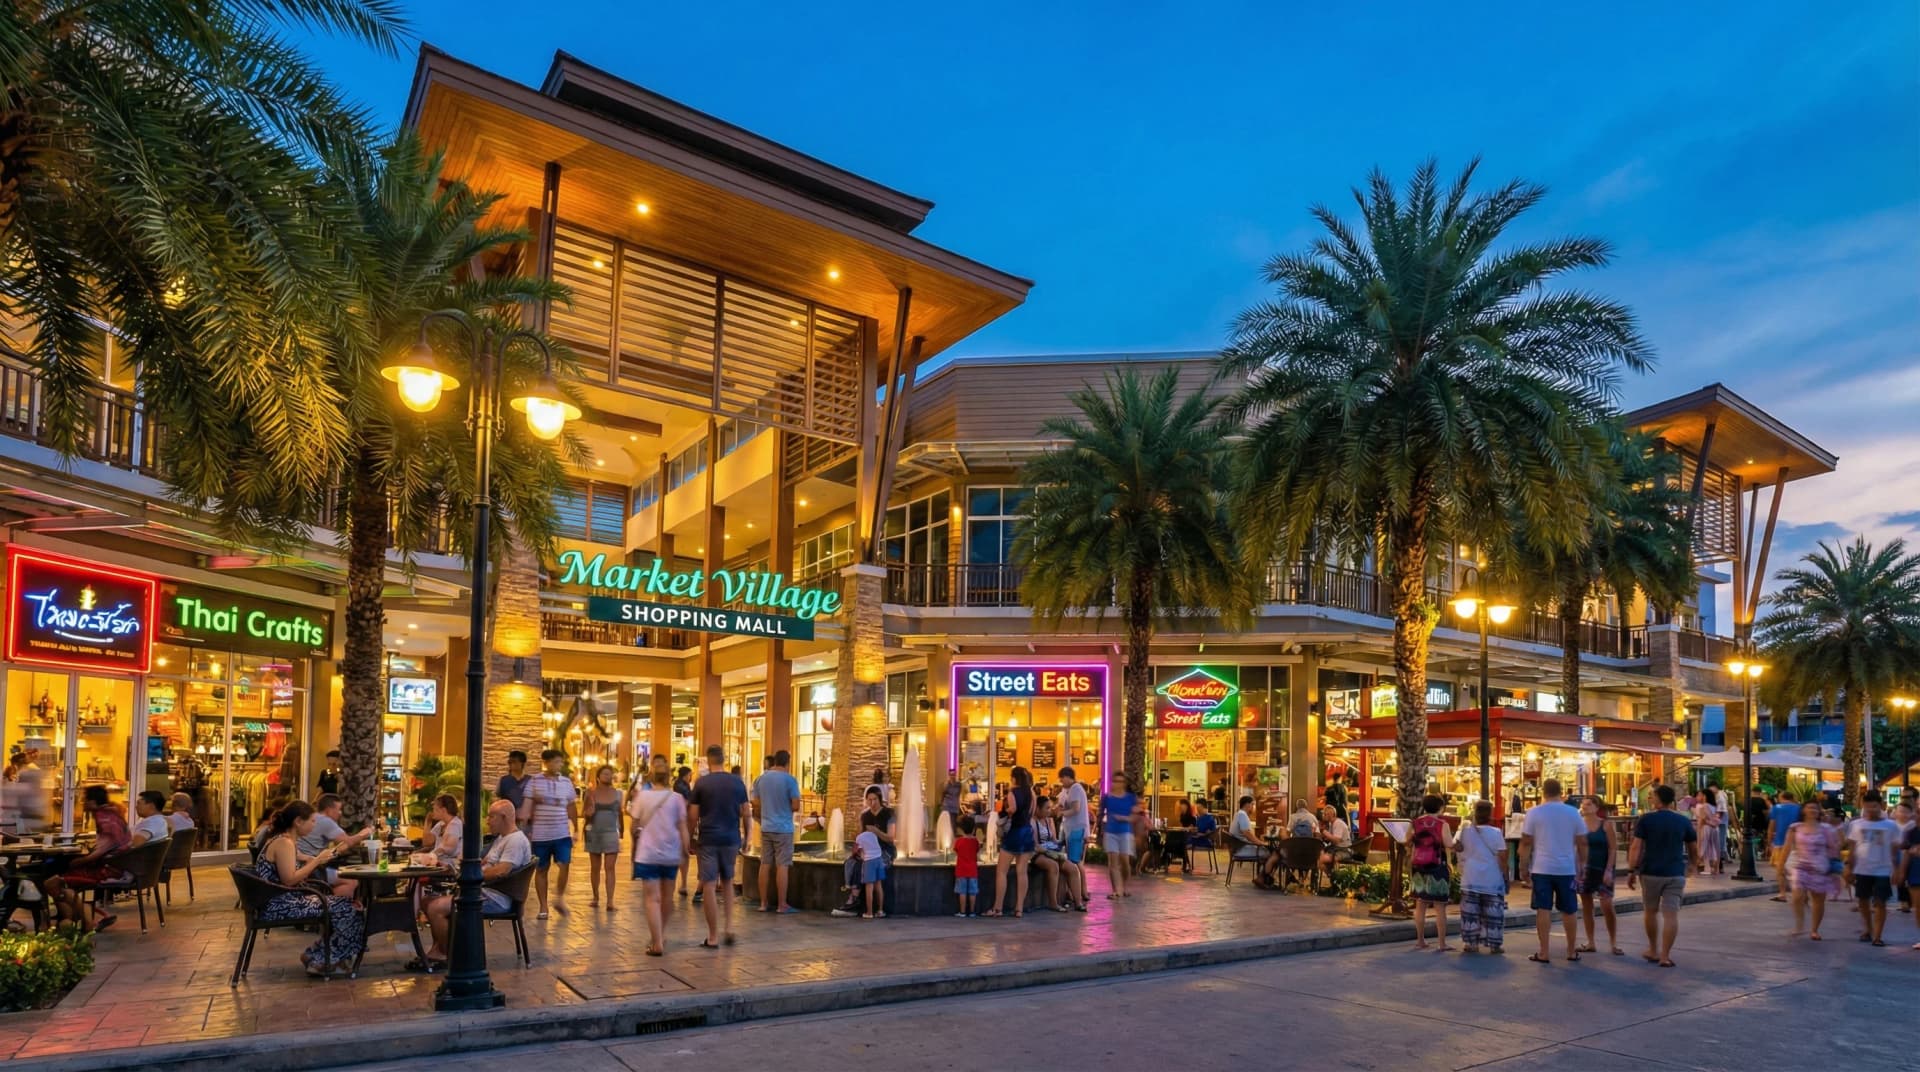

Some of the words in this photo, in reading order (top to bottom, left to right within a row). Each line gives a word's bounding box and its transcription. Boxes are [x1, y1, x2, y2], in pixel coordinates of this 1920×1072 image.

[559, 550, 706, 598] Market
[711, 569, 842, 620] Village
[176, 597, 238, 633] Thai
[247, 611, 323, 646] Crafts
[621, 604, 728, 629] SHOPPING
[735, 616, 787, 635] MALL
[967, 671, 1035, 692] Street
[1041, 671, 1091, 692] Eats
[1163, 711, 1201, 725] Street
[1201, 711, 1231, 725] Eats
